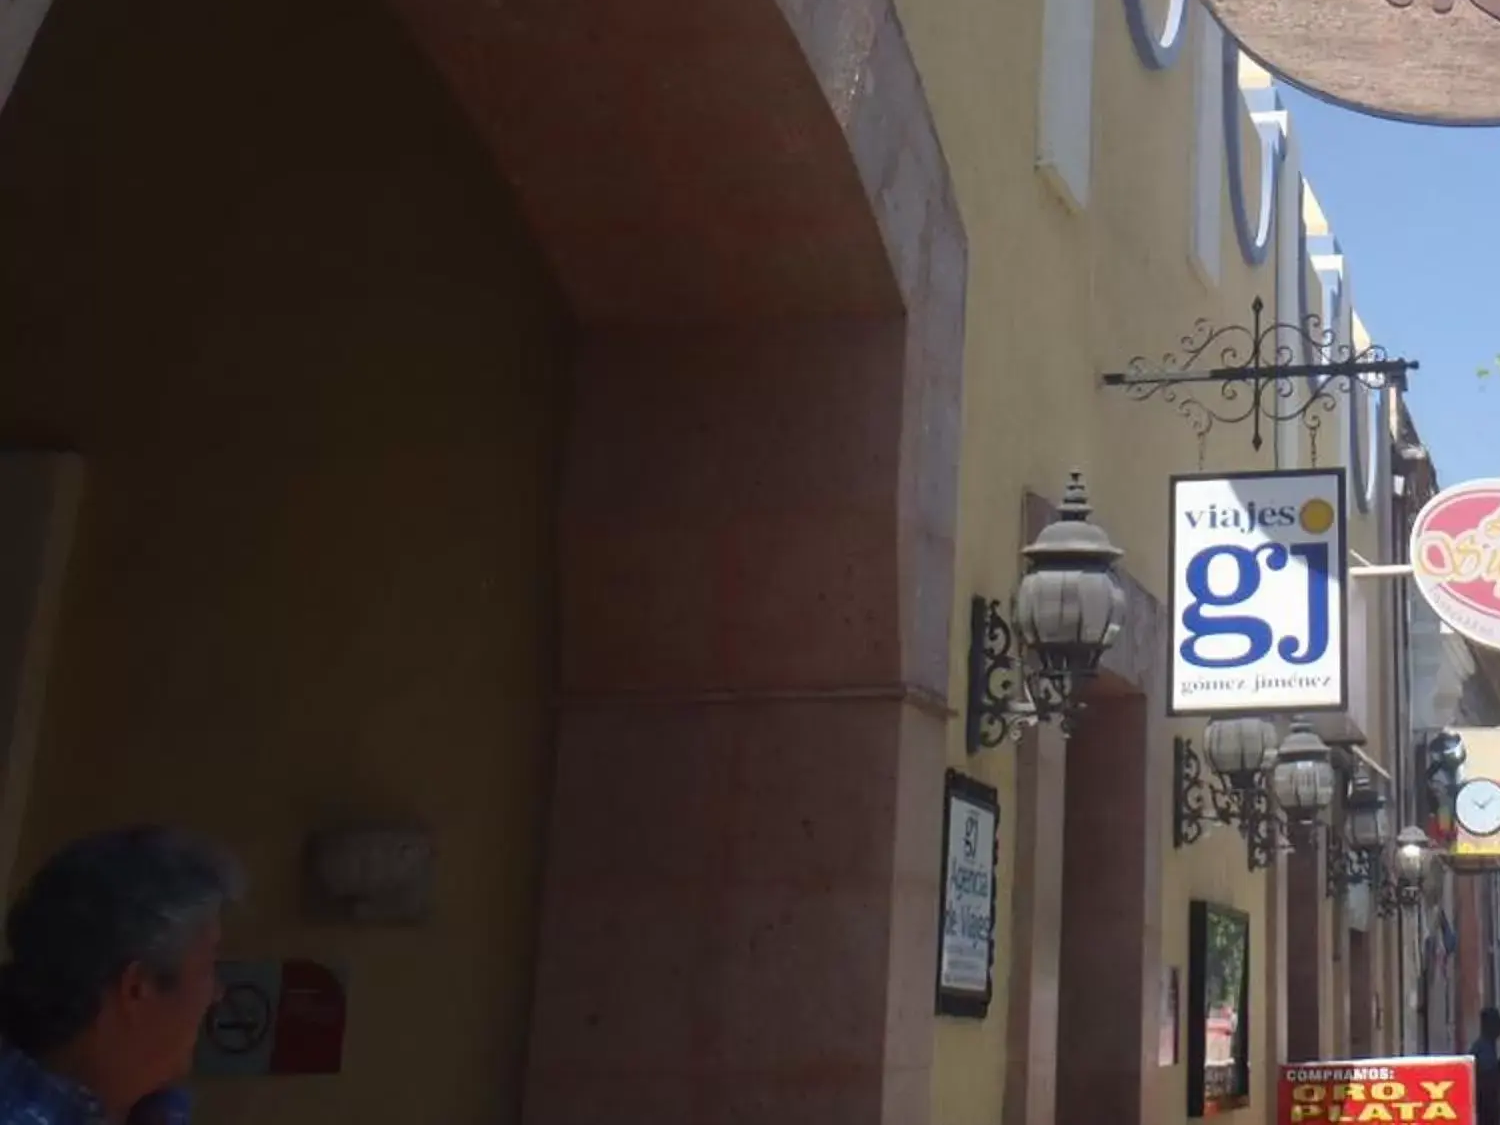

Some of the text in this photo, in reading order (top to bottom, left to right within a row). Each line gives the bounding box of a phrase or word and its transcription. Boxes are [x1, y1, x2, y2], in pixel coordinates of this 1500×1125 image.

[1185, 501, 1296, 534] viajes
[1180, 541, 1330, 669] gj
[1286, 1067, 1395, 1082] COMPRAMOS:
[1292, 1080, 1456, 1103] ORO Y
[1290, 1102, 1458, 1123] PLATA
